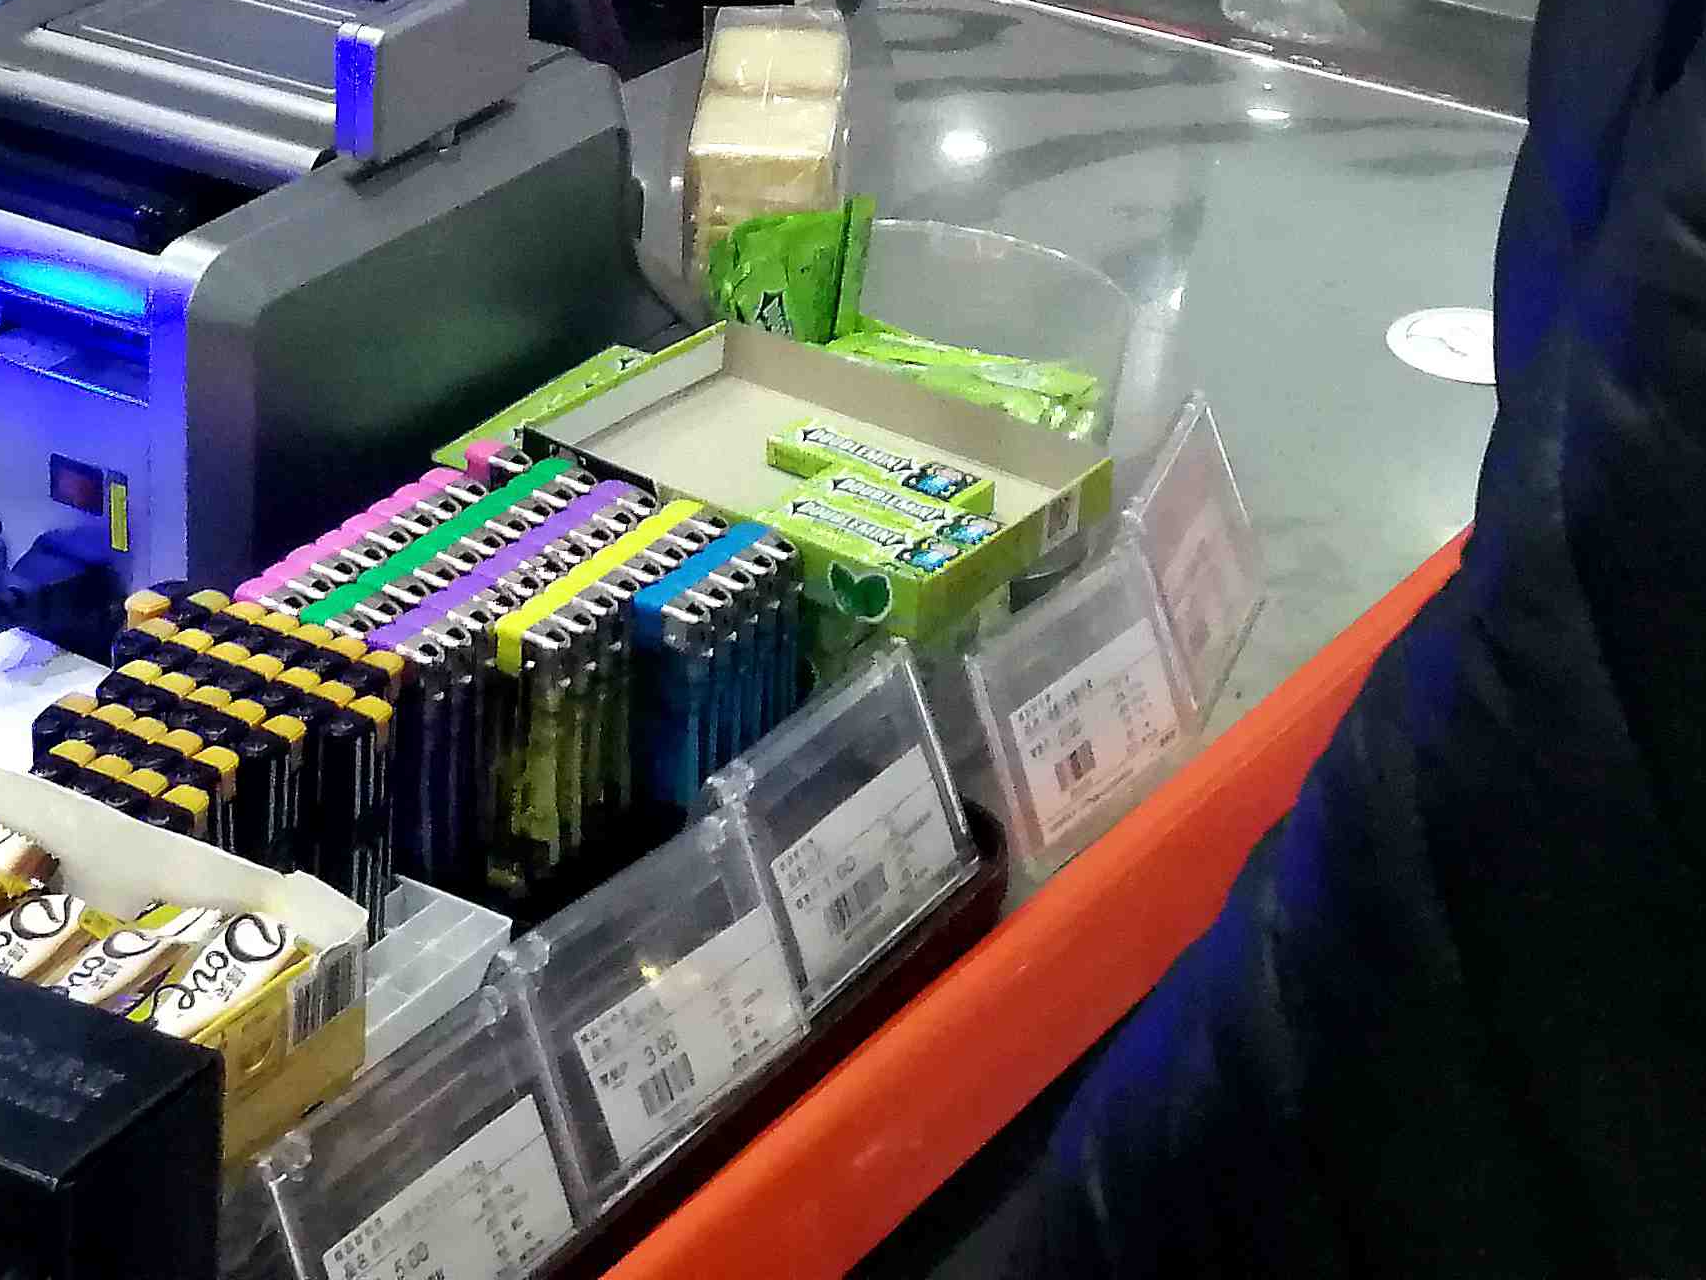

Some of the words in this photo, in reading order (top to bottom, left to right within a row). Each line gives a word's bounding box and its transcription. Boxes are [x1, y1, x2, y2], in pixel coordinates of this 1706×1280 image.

[810, 426, 913, 473] DOUBLEMINT
[800, 499, 907, 546] DOUBLEMINT
[839, 476, 945, 522] DOUBLEMINT
